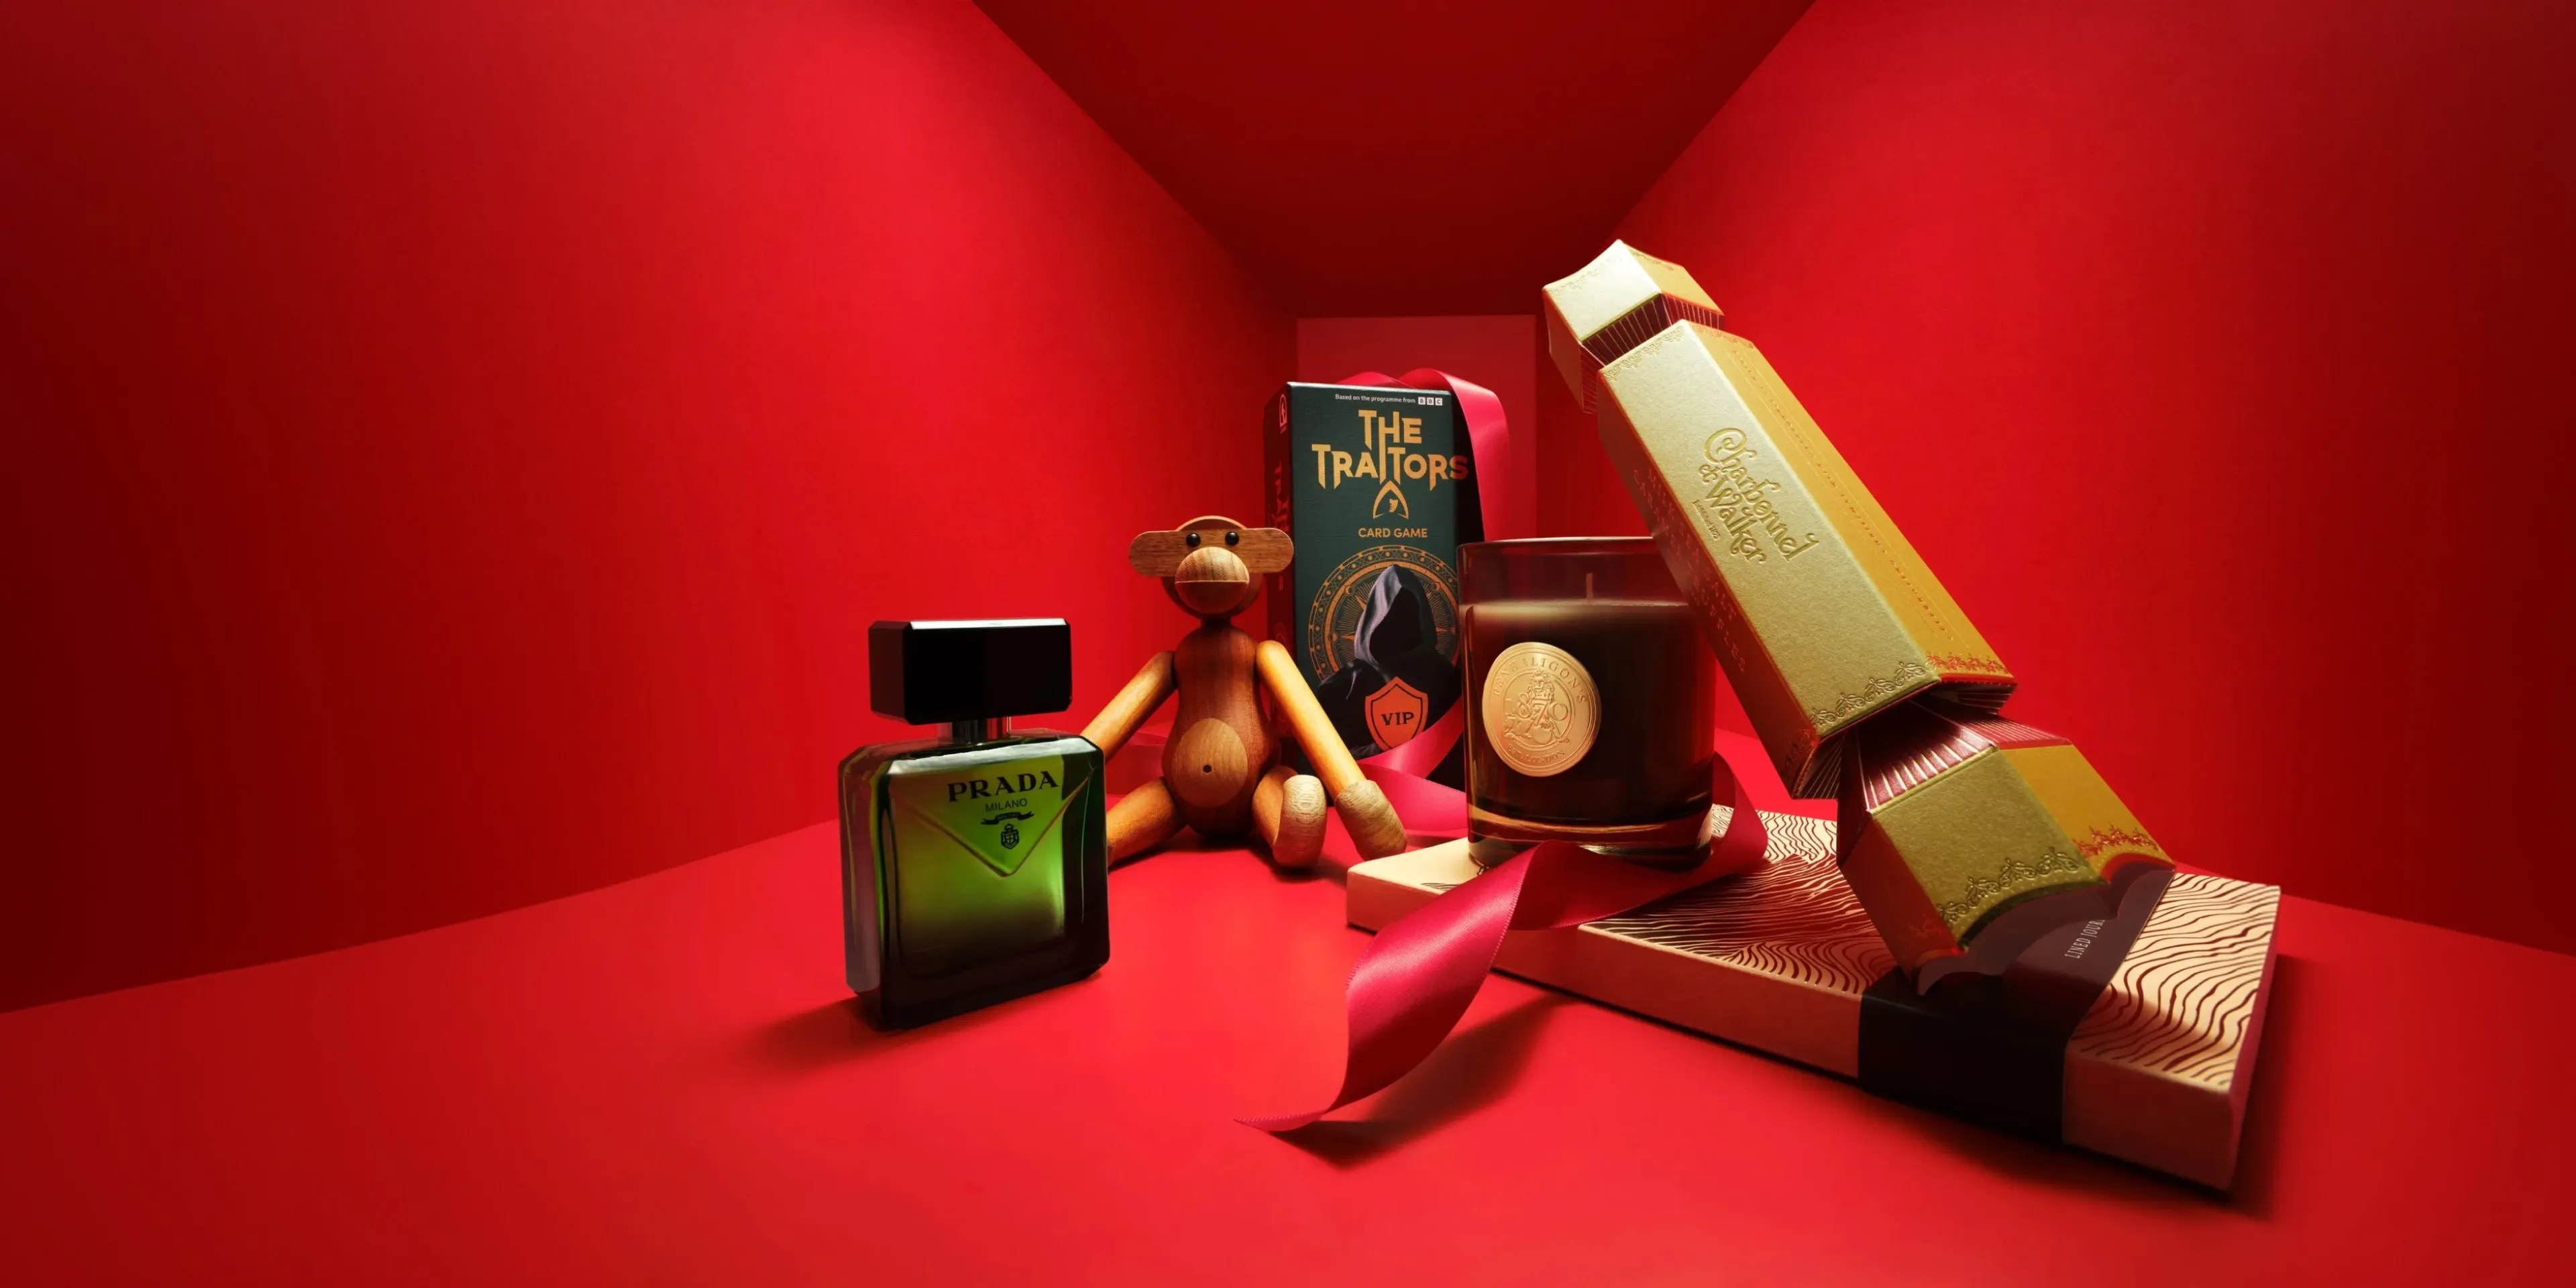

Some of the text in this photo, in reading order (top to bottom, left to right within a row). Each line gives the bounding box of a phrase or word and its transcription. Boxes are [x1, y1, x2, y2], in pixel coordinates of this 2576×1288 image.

[1358, 409, 1423, 451] THE
[1311, 444, 1469, 491] TRAITORS
[1704, 427, 1820, 562] Charbonnel
[1358, 527, 1428, 539] CARD GAME
[1705, 476, 1767, 563] Walker
[1381, 712, 1415, 727] VIP
[947, 771, 1060, 803] PRADA
[985, 798, 1028, 812] MILANO
[2064, 920, 2105, 959] LINED JOUR
